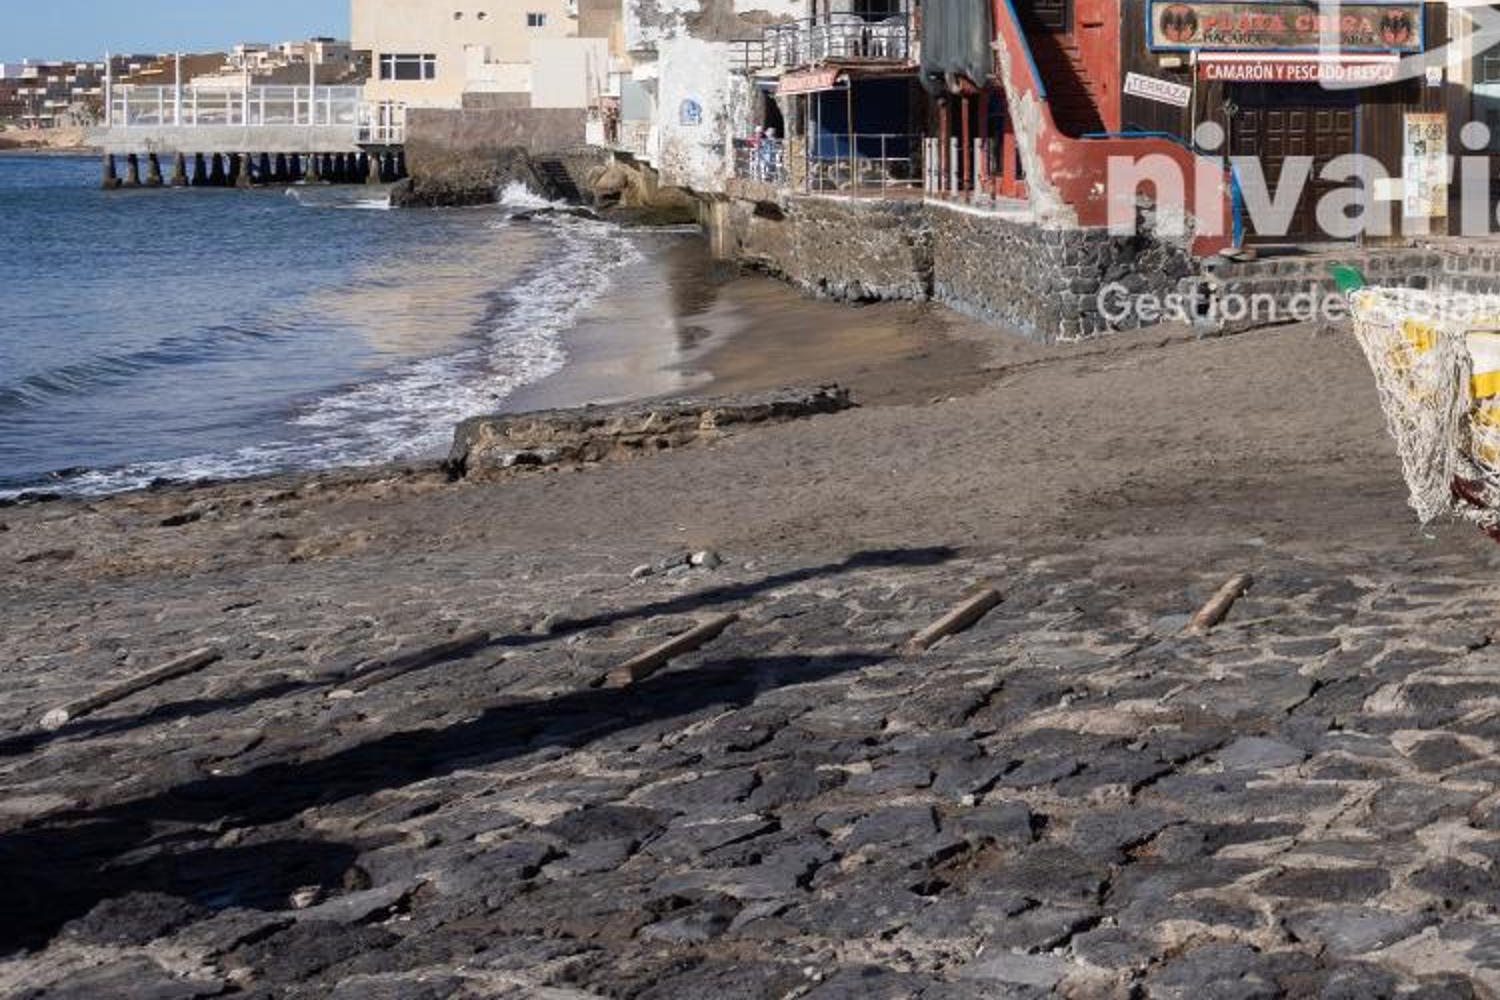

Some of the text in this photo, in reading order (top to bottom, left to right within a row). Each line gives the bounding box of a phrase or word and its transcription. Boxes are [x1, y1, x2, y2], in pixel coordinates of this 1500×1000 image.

[1206, 61, 1393, 81] CAMARÓN Y PESCADO FRESCO
